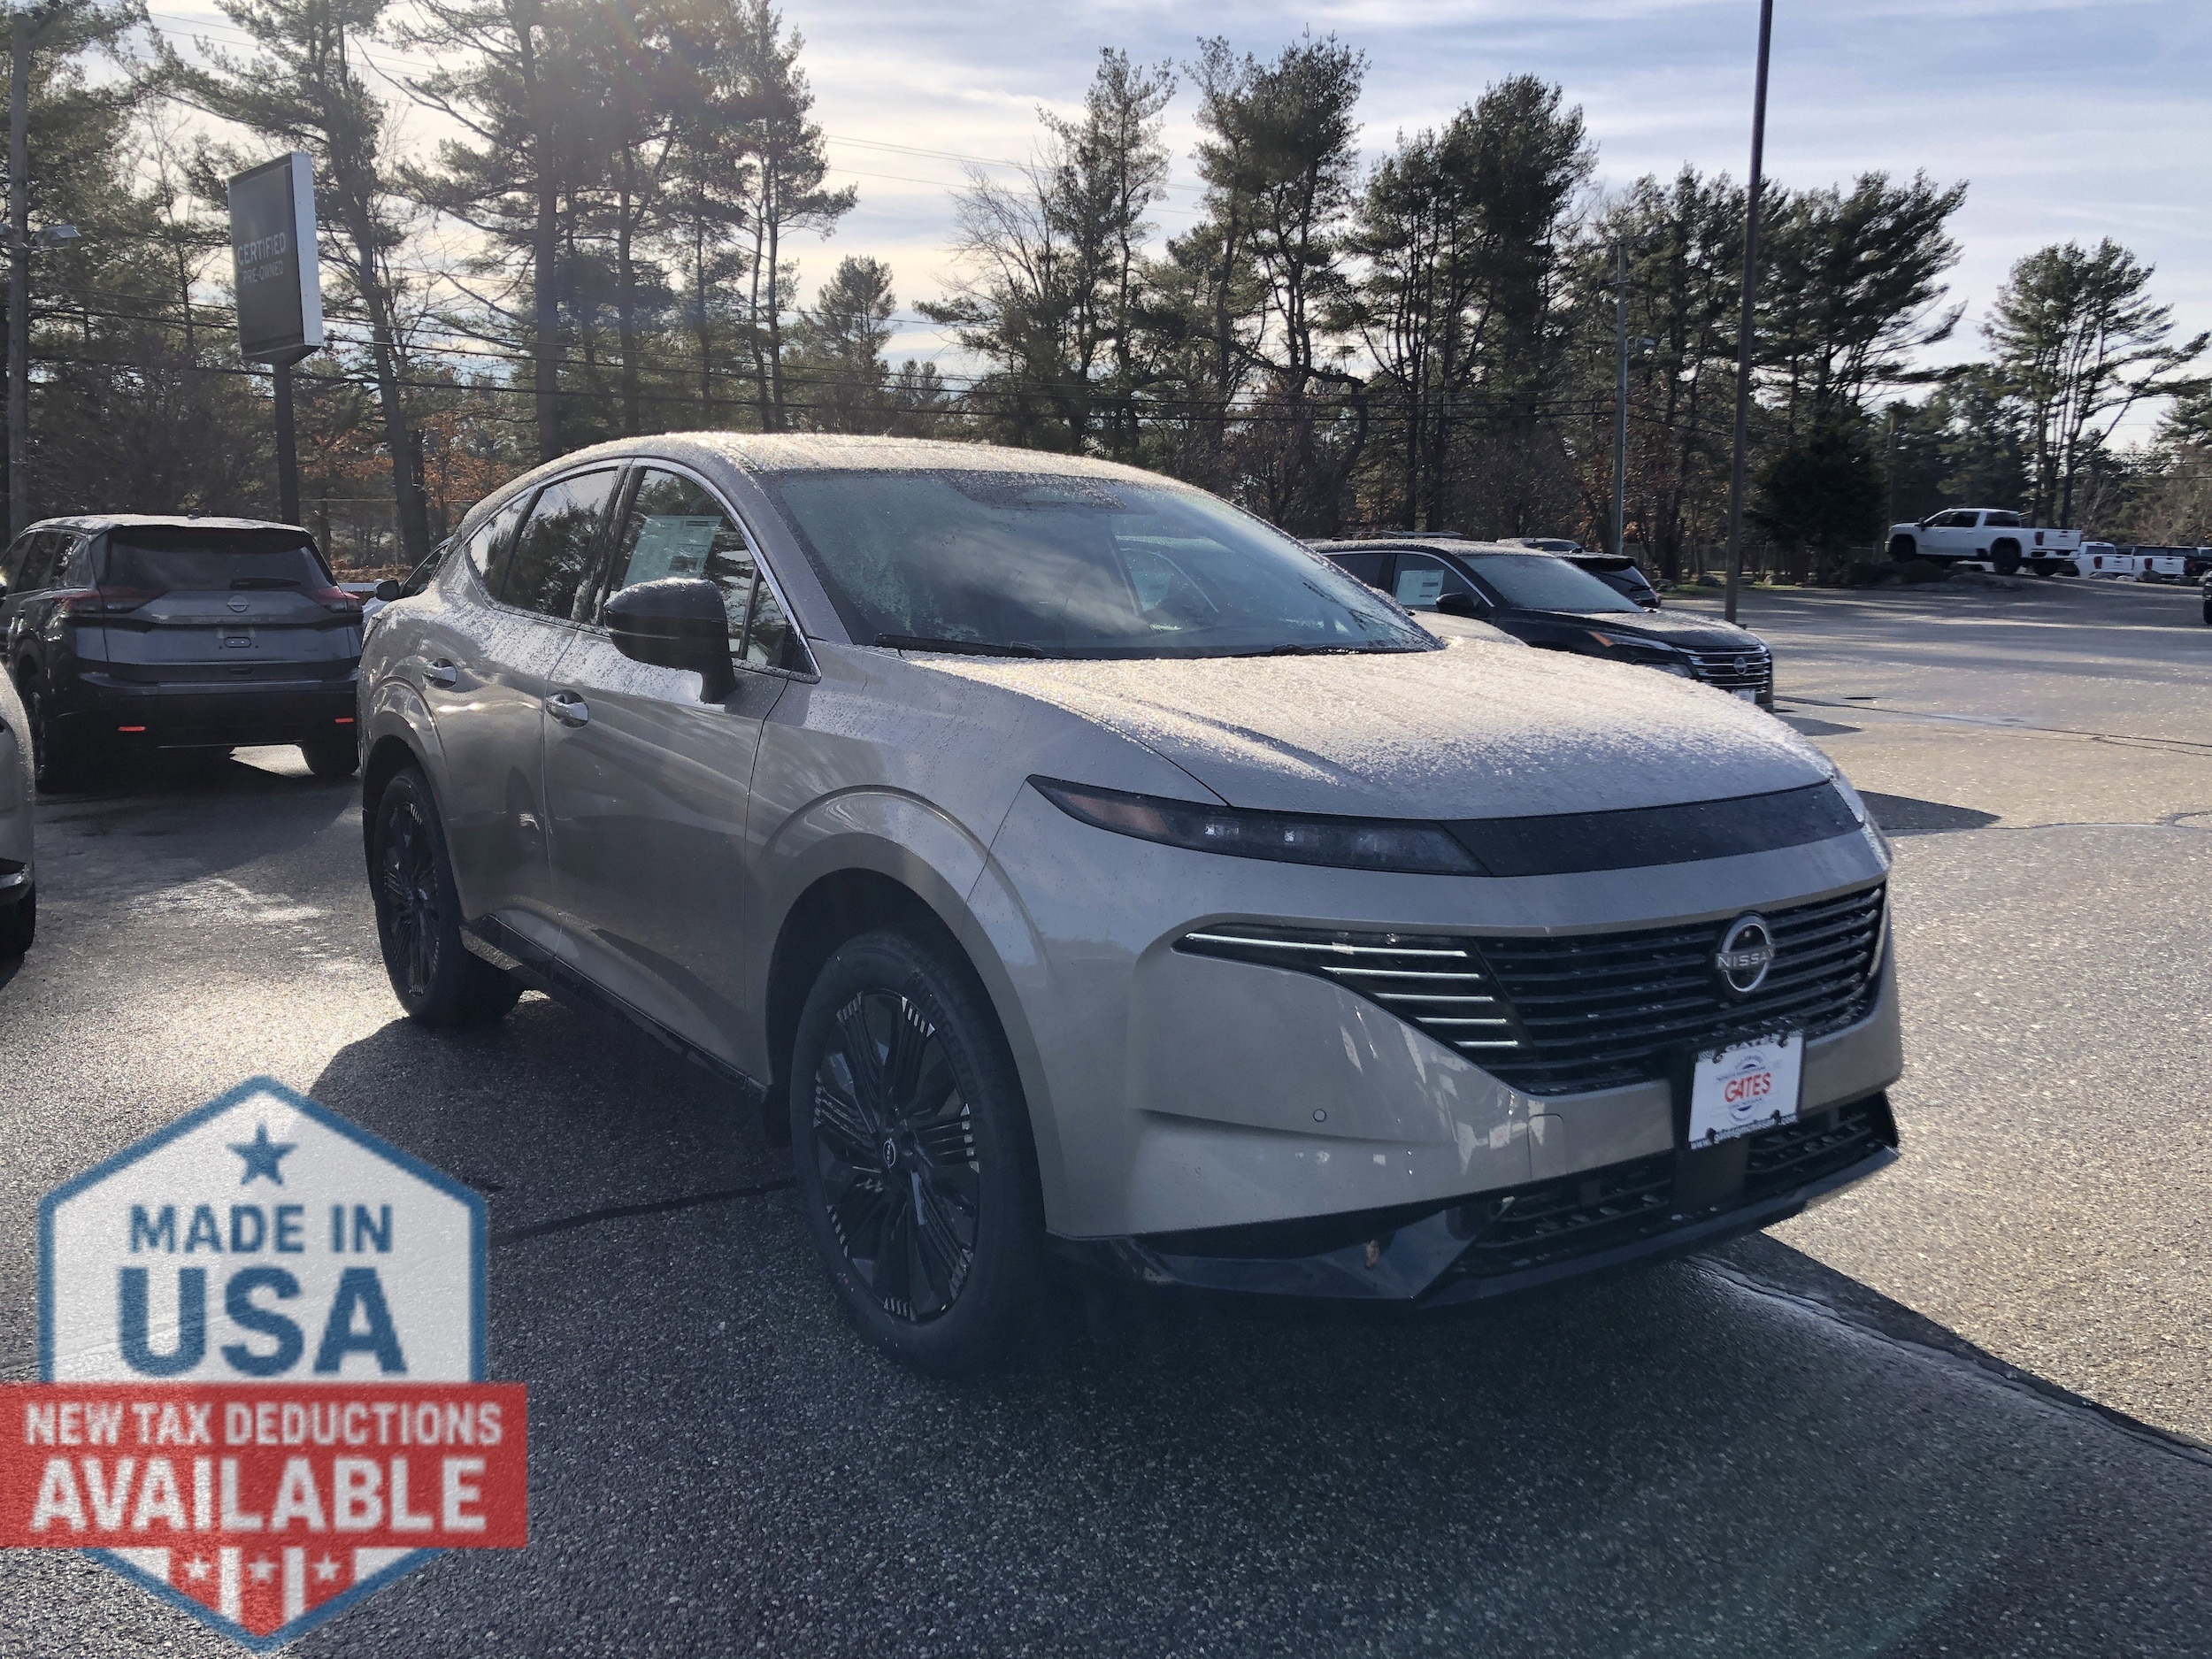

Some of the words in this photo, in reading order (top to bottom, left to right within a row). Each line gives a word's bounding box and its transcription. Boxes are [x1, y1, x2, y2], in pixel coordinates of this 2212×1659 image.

[237, 232, 287, 266] CERTIFIED
[242, 259, 284, 285] PRE-OWNED
[1717, 949, 1774, 968] NISSAN
[1724, 1071, 1772, 1102] GATES
